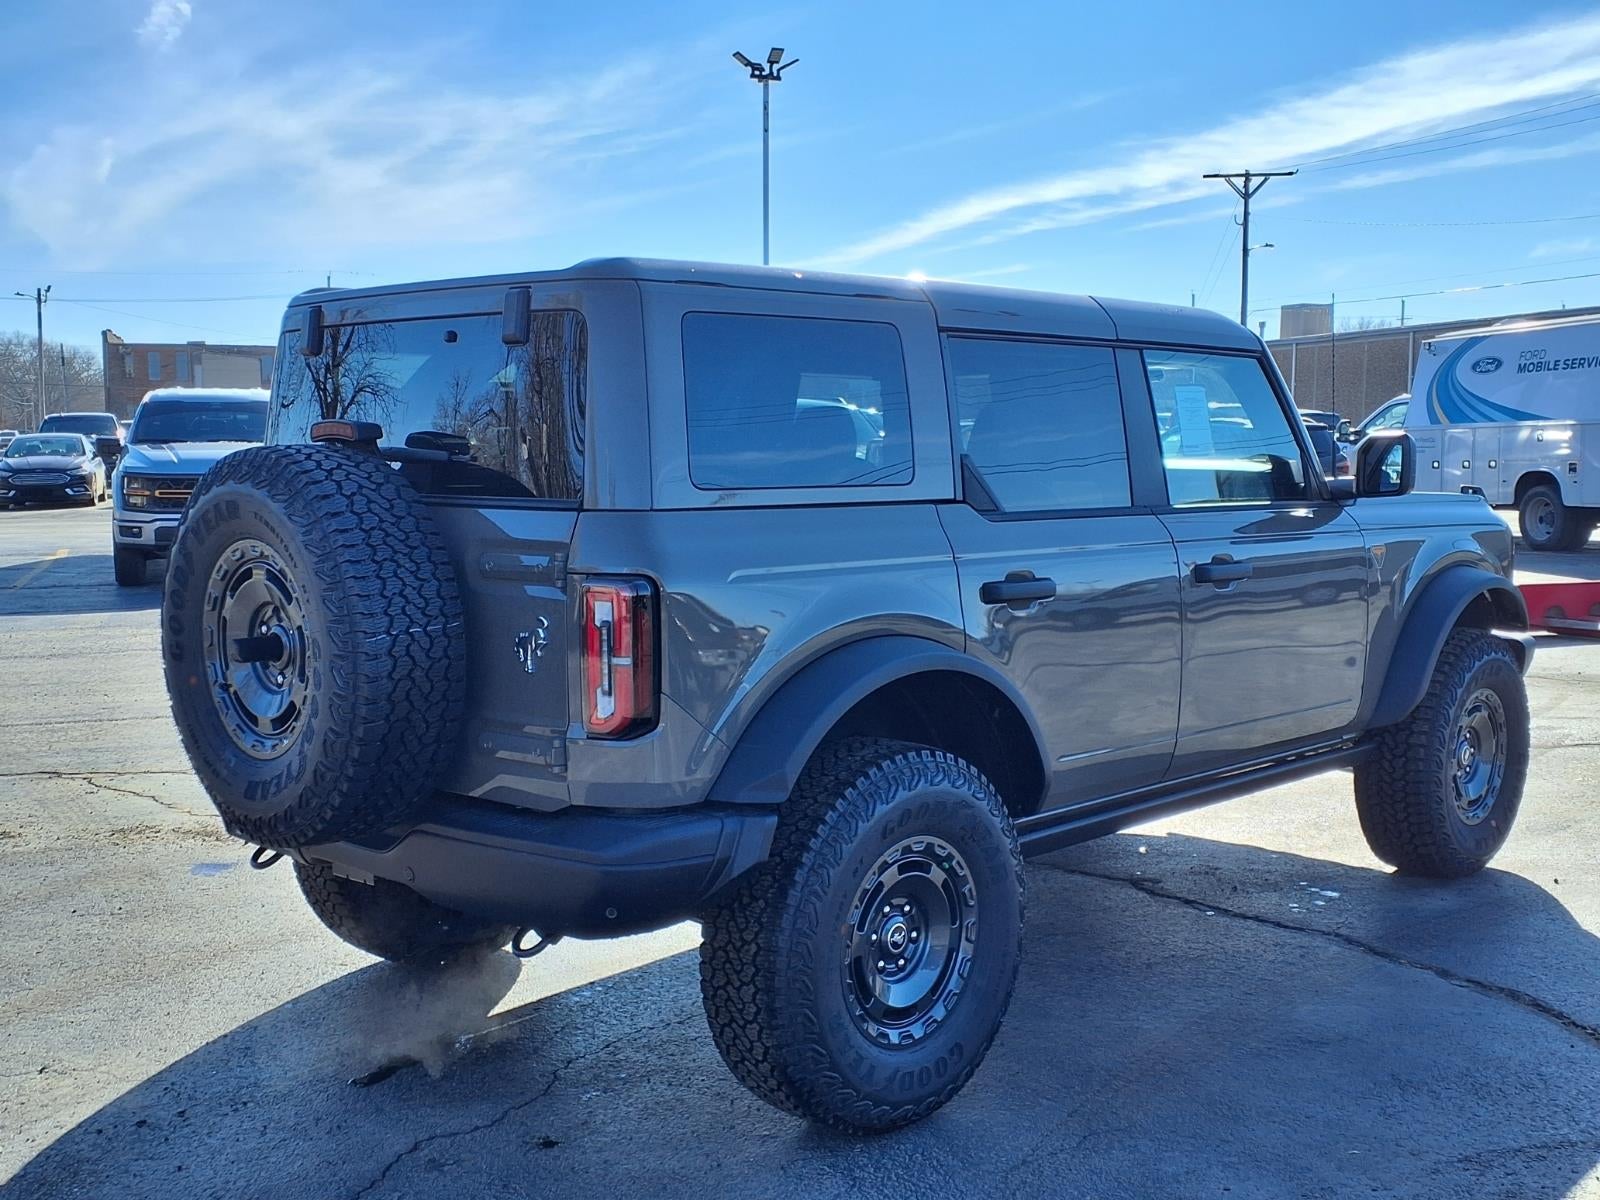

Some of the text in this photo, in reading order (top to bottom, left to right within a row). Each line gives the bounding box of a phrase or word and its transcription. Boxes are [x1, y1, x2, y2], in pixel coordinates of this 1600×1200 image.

[1519, 349, 1547, 361] FORD
[1517, 356, 1600, 374] MOBILE SERVI
